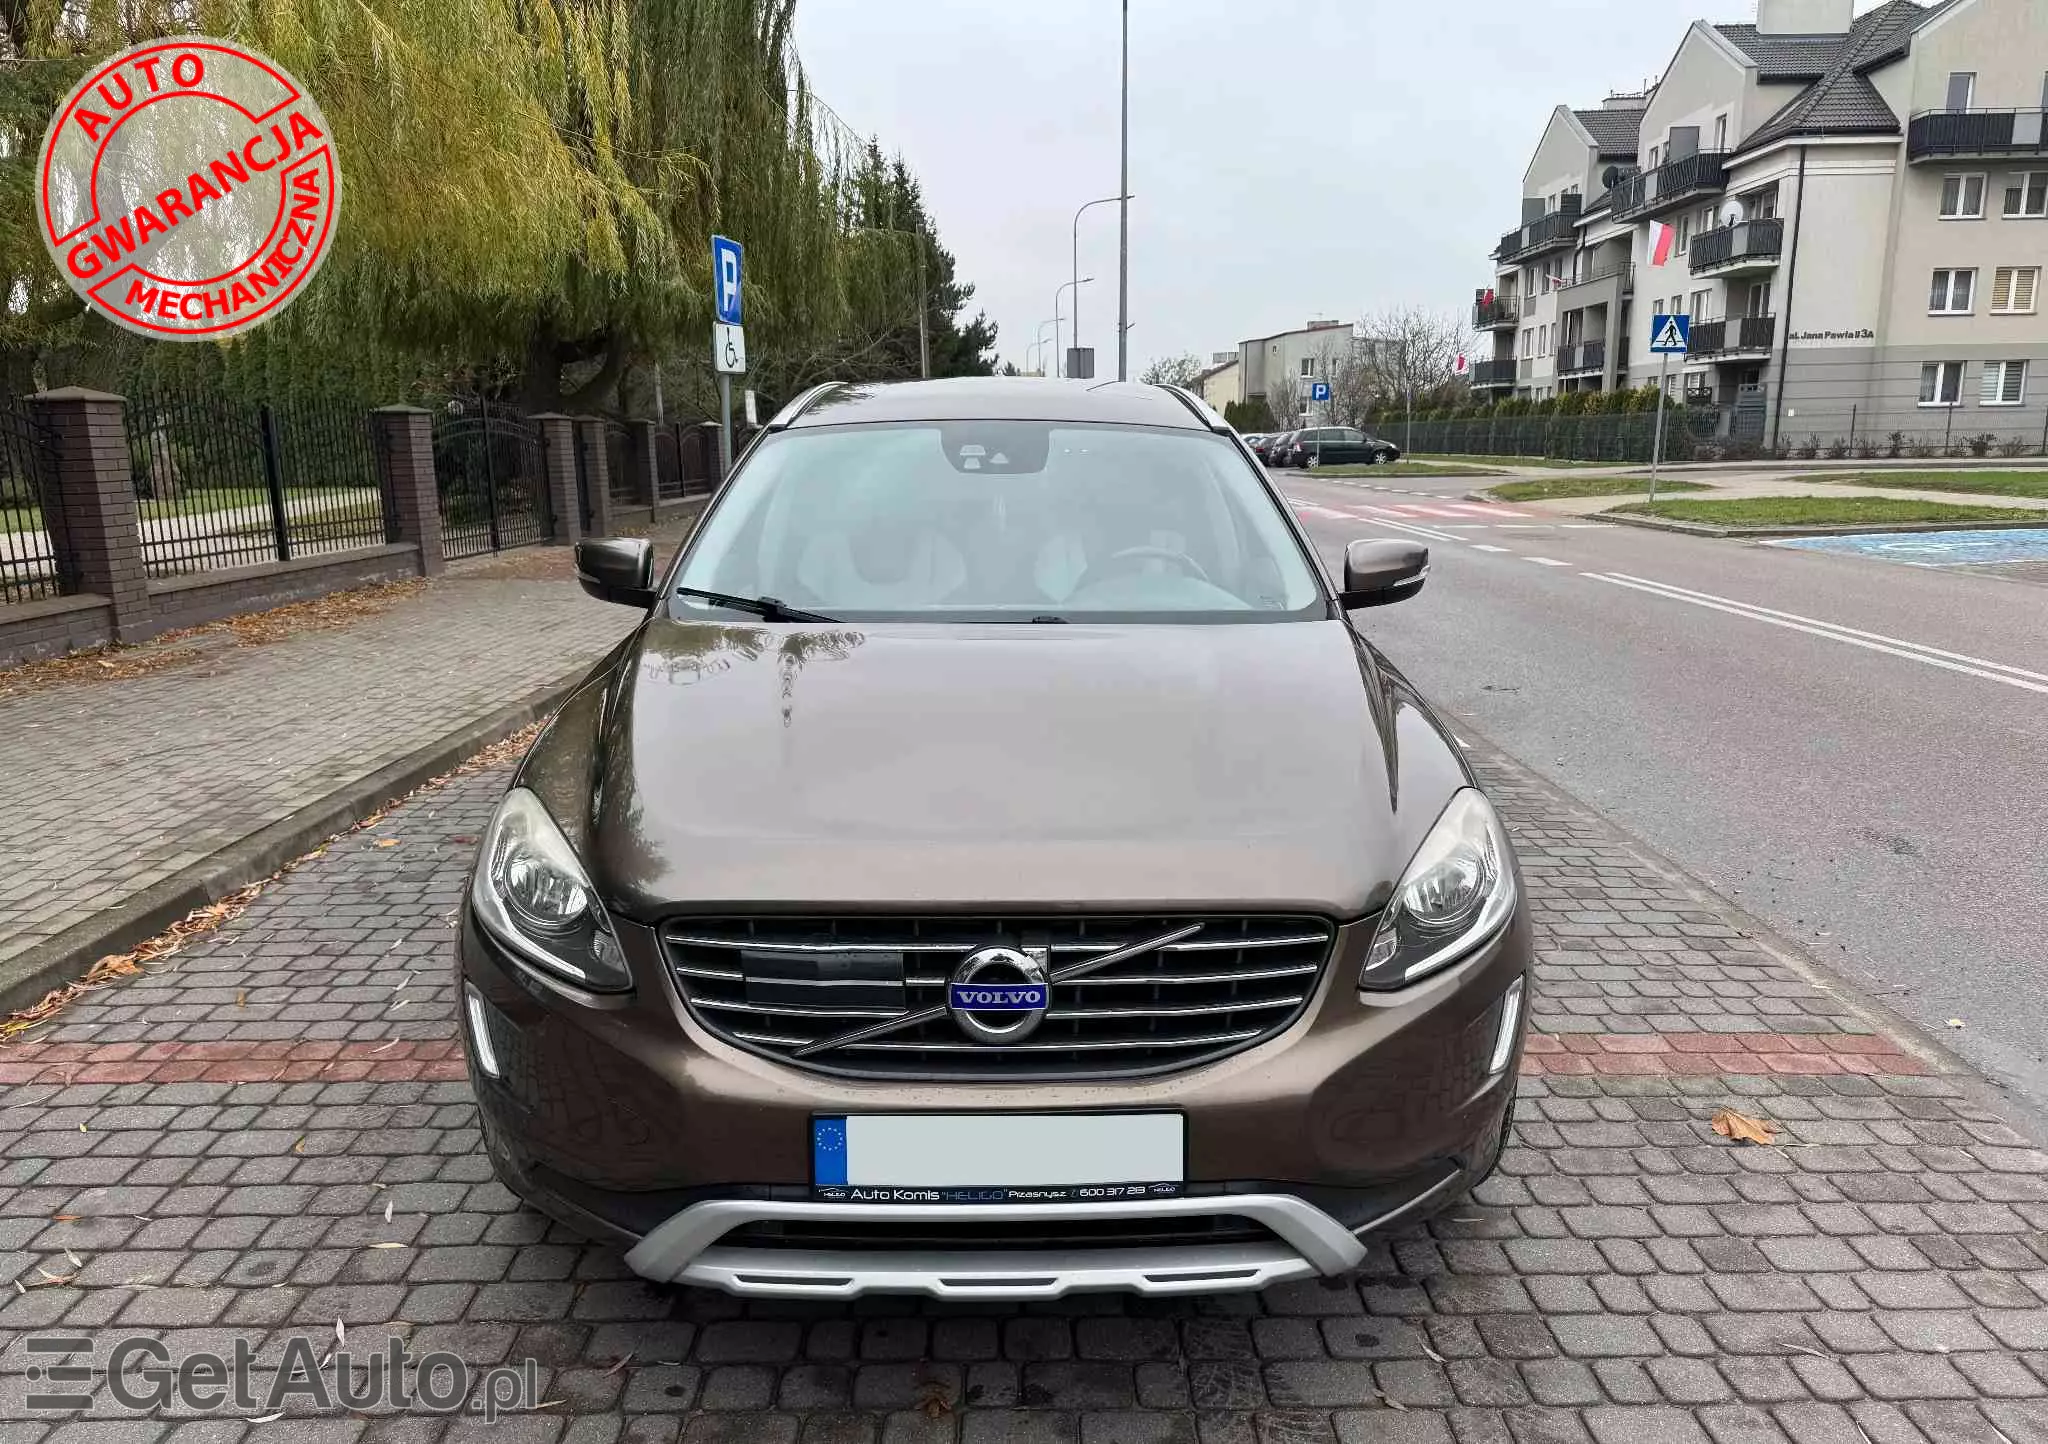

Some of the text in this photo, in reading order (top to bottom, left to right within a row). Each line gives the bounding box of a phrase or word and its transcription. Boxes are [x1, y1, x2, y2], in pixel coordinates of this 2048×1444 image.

[721, 248, 738, 312] P
[1801, 331, 1823, 340] Jana
[1861, 329, 1874, 338] 3A
[1316, 384, 1327, 398] P
[957, 991, 1041, 1004] VOLVO
[850, 1189, 890, 1200] Auto
[893, 1190, 940, 1201] Komis
[1079, 1188, 1105, 1197] 600
